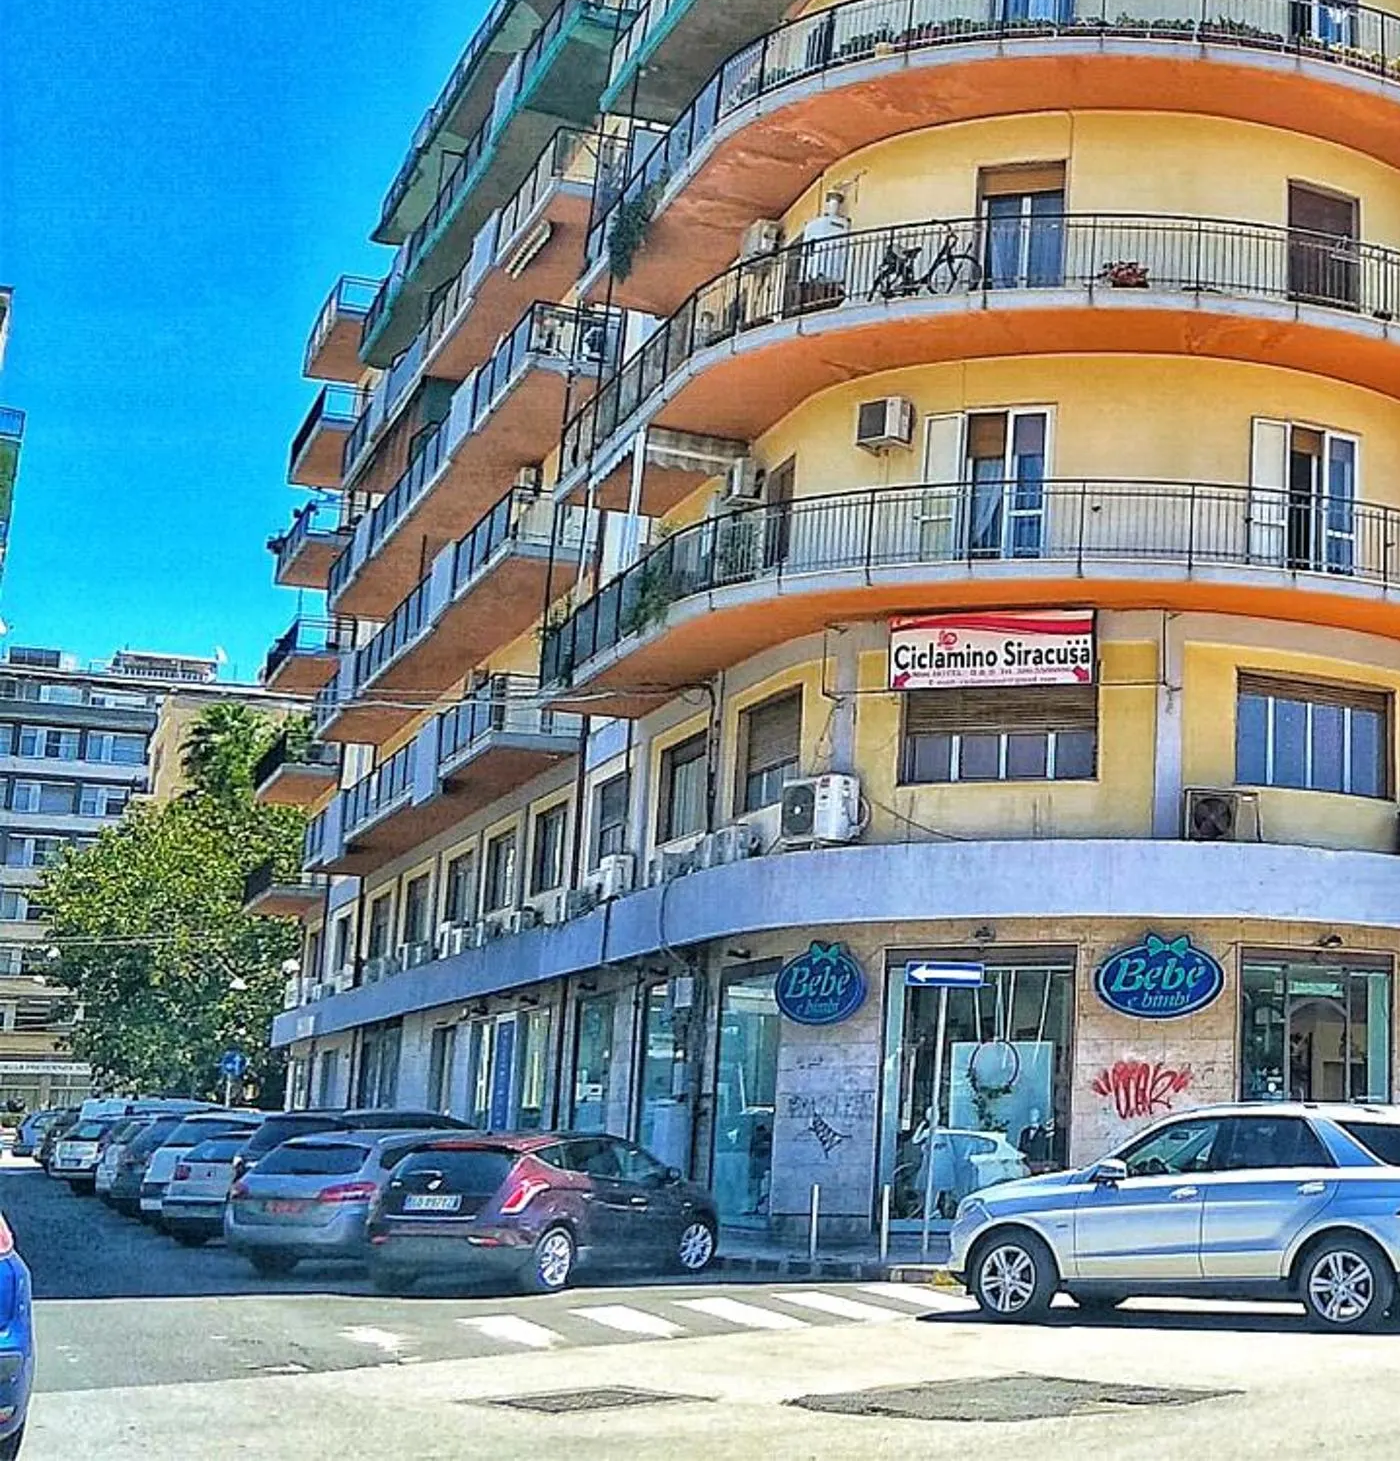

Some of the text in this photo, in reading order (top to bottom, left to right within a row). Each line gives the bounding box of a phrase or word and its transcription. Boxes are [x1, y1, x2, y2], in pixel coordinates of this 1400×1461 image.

[894, 640, 1090, 671] Ciclamino Siracusa
[785, 964, 851, 998] Bebè
[1110, 957, 1206, 992] Bebè
